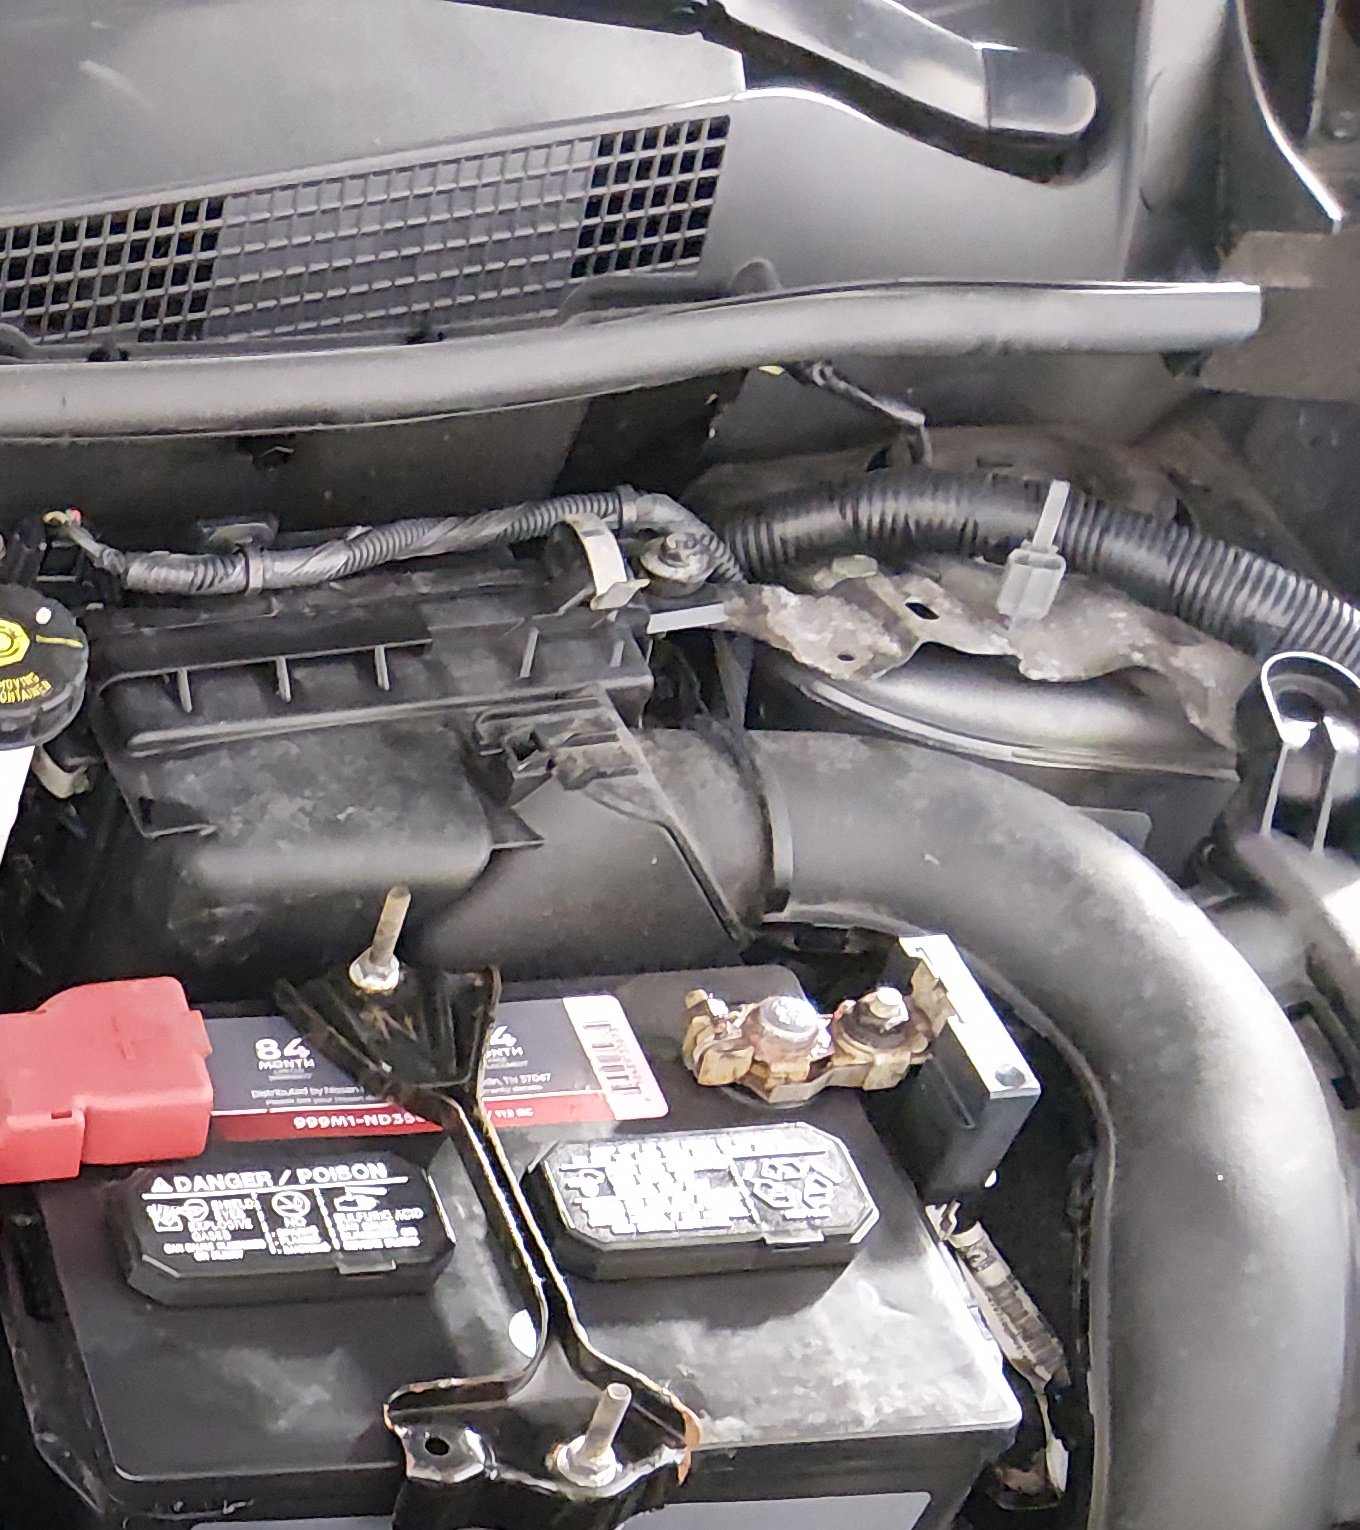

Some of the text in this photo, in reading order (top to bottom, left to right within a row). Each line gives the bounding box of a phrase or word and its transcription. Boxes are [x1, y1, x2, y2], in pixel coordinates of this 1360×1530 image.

[254, 1037, 311, 1061] 84
[258, 1058, 315, 1071] MONTH
[173, 1171, 274, 1193] DANGER
[296, 1163, 389, 1185] POISON
